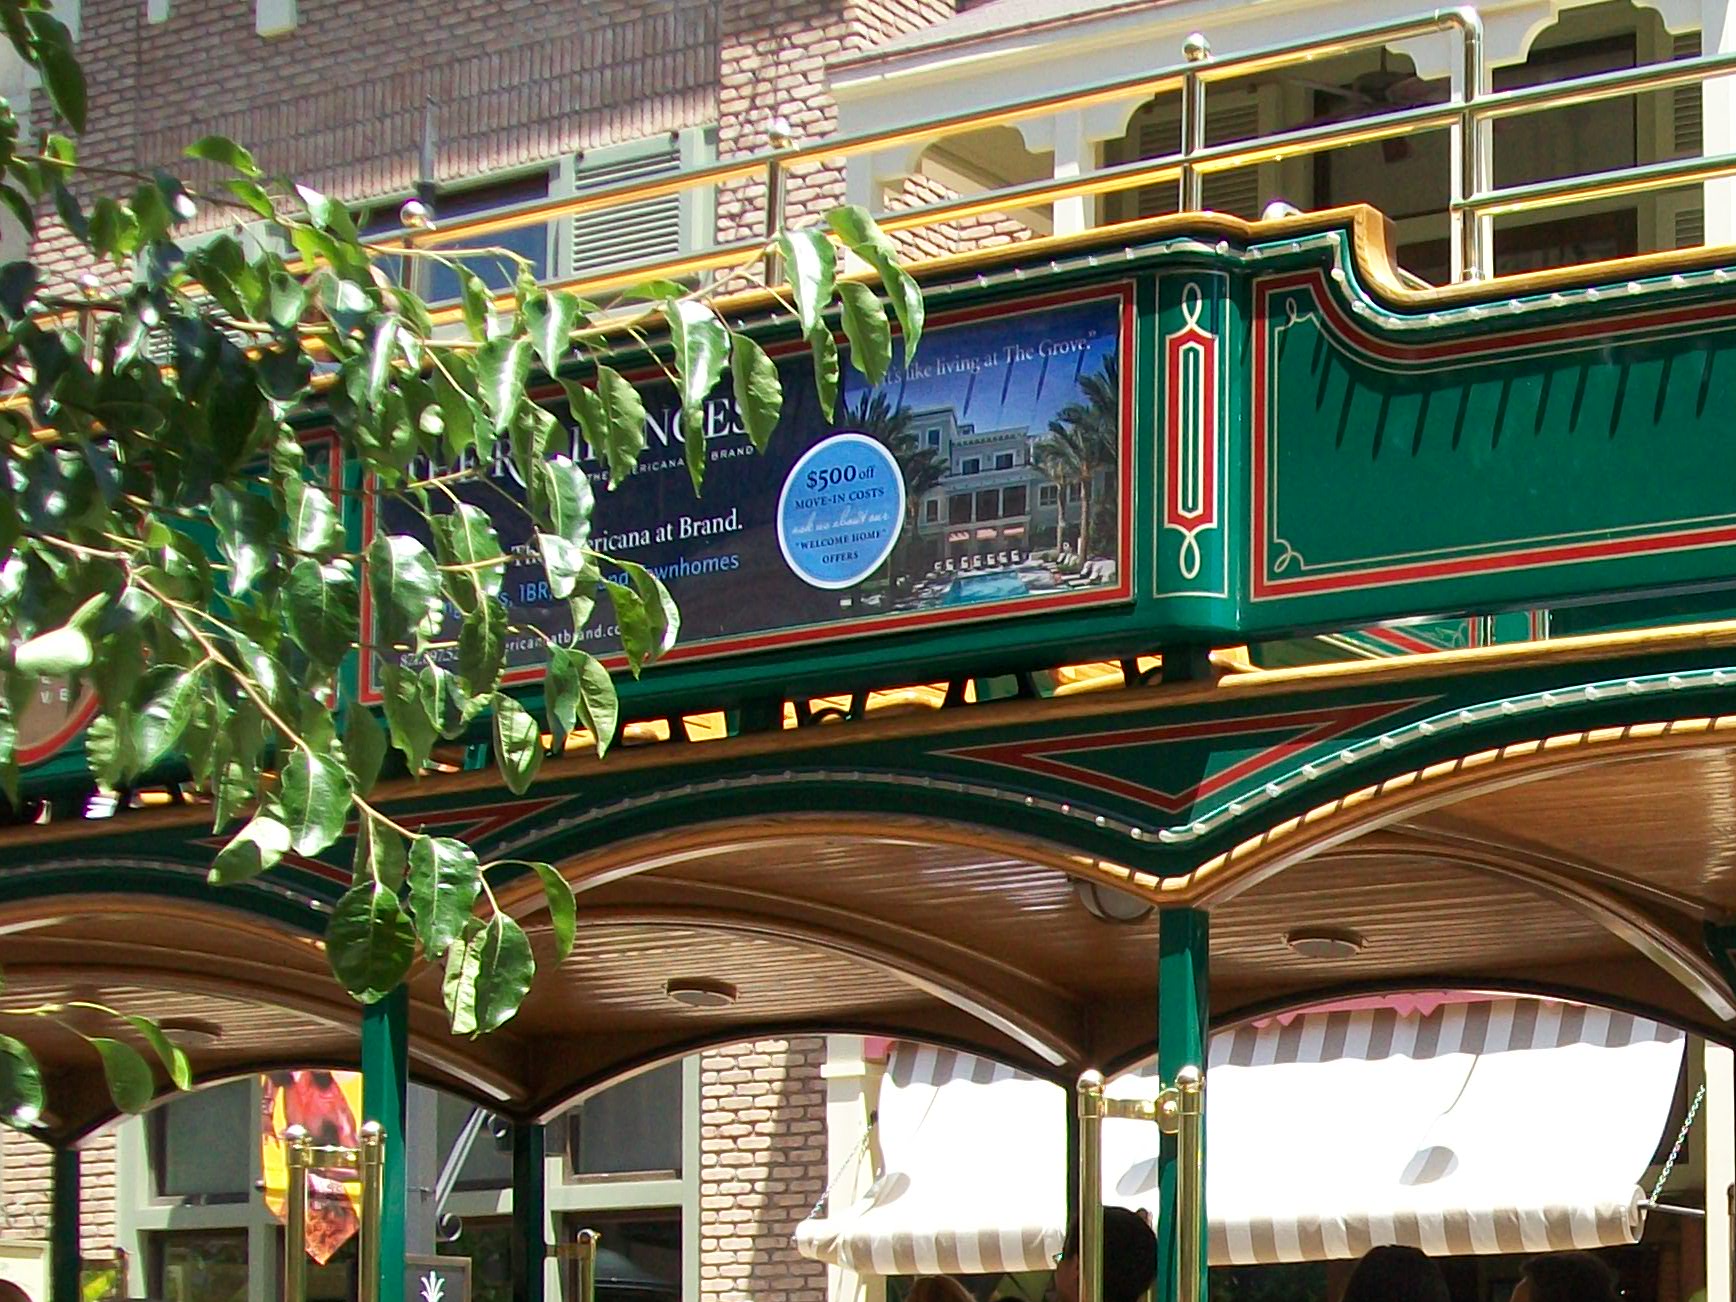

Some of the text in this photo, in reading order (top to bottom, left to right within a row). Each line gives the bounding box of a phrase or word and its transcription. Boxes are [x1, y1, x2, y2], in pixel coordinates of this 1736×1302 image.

[905, 361, 932, 381] like
[937, 354, 979, 375] living
[984, 353, 998, 367] at
[1003, 345, 1033, 363] The
[587, 471, 608, 481] THE
[711, 445, 754, 461] BRAND
[806, 465, 876, 492] $500 off
[795, 487, 885, 511] MOVE-IN COSTS
[655, 522, 673, 543] at
[679, 508, 743, 539] Brand.
[822, 551, 859, 564] OFFERS
